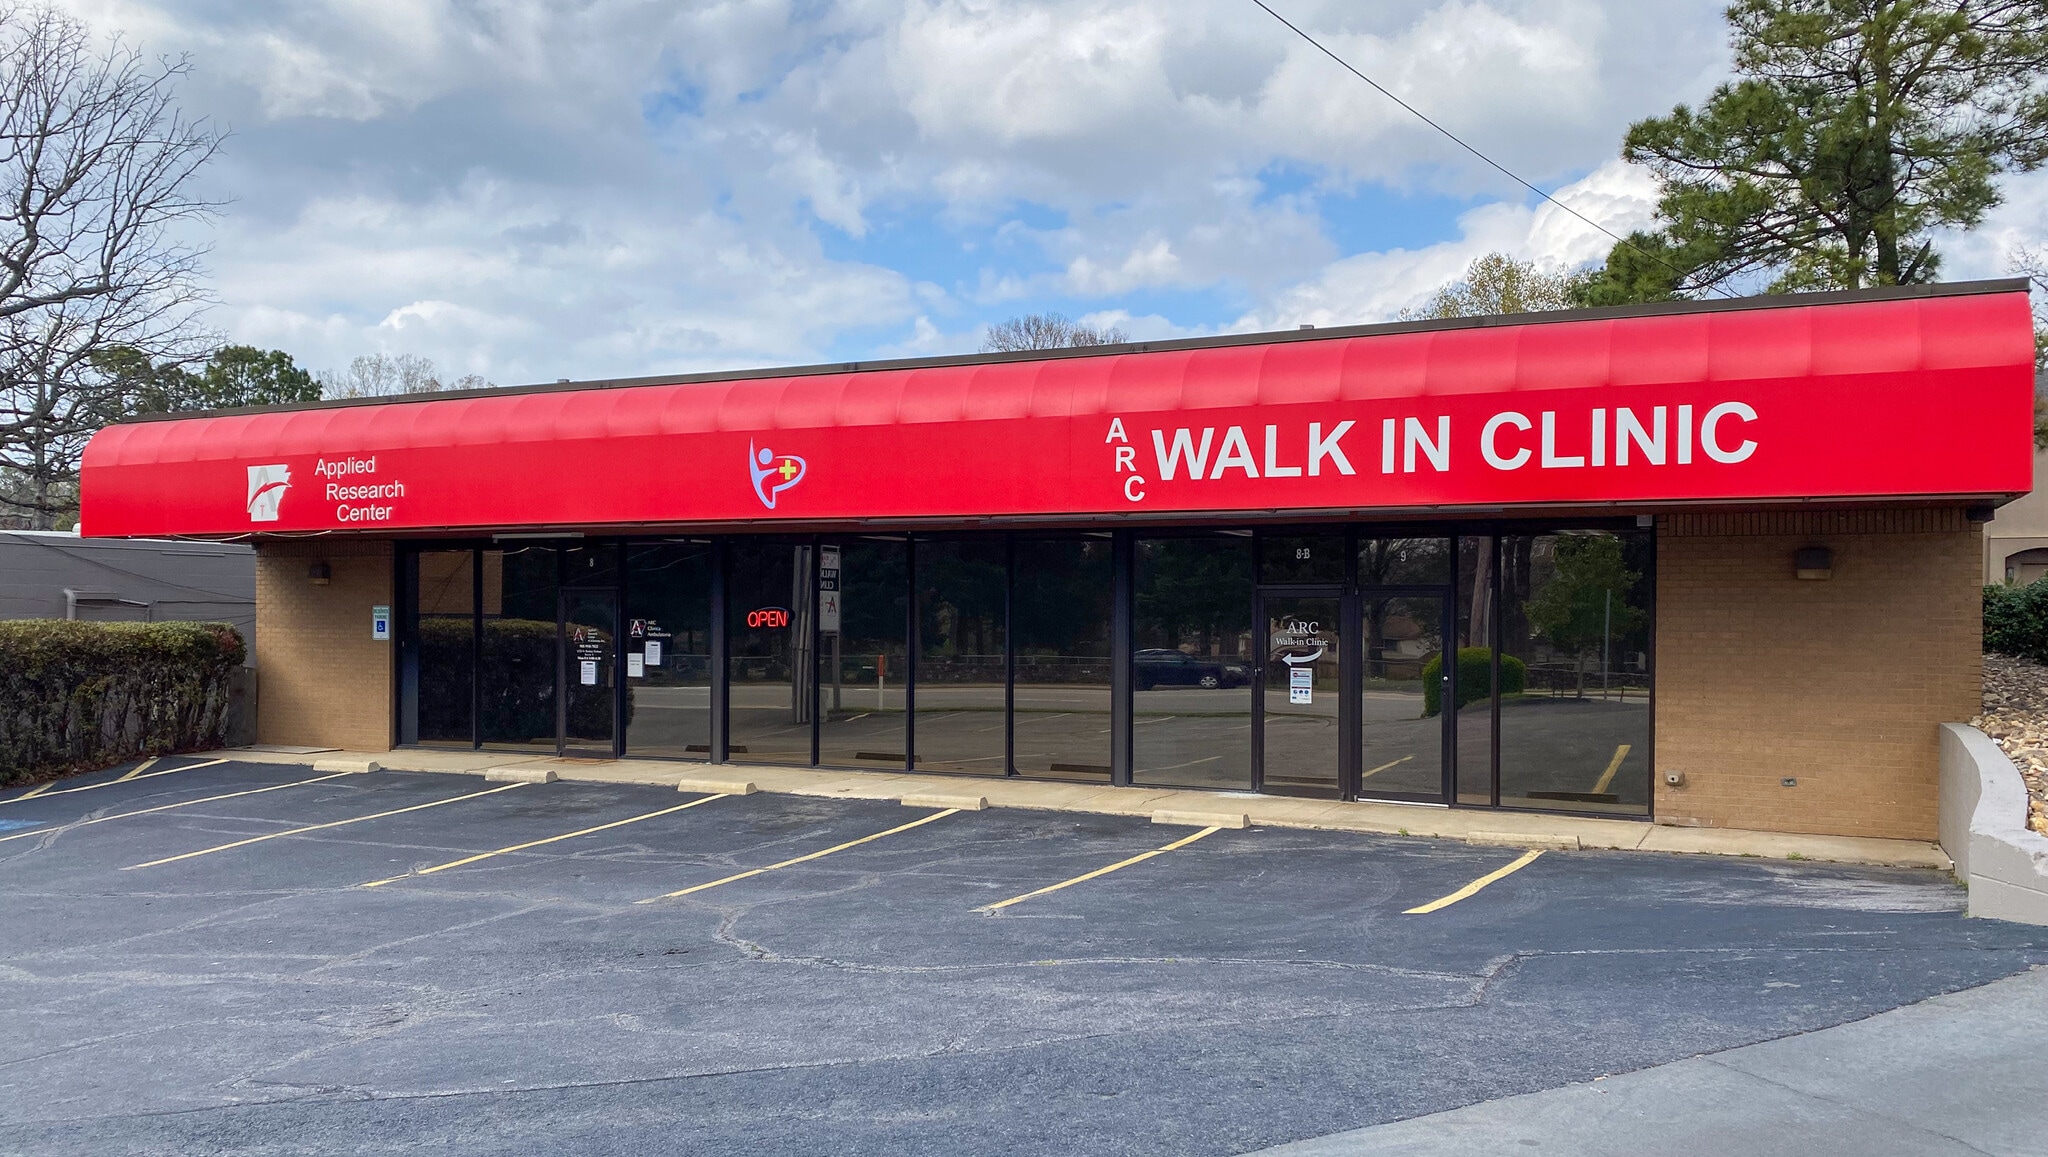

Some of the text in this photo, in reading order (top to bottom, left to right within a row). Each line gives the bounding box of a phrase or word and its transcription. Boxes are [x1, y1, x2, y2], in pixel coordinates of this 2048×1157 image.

[1151, 401, 1759, 482] WALK IN CLINIC
[314, 456, 376, 479] Applied
[1105, 417, 1146, 503] ARC
[326, 480, 405, 501] Research
[336, 503, 393, 522] Center
[1400, 550, 1407, 562] 9
[747, 611, 787, 628] OPEN
[1286, 621, 1319, 635] ARC
[1276, 637, 1329, 646] Walk-in Clinic
